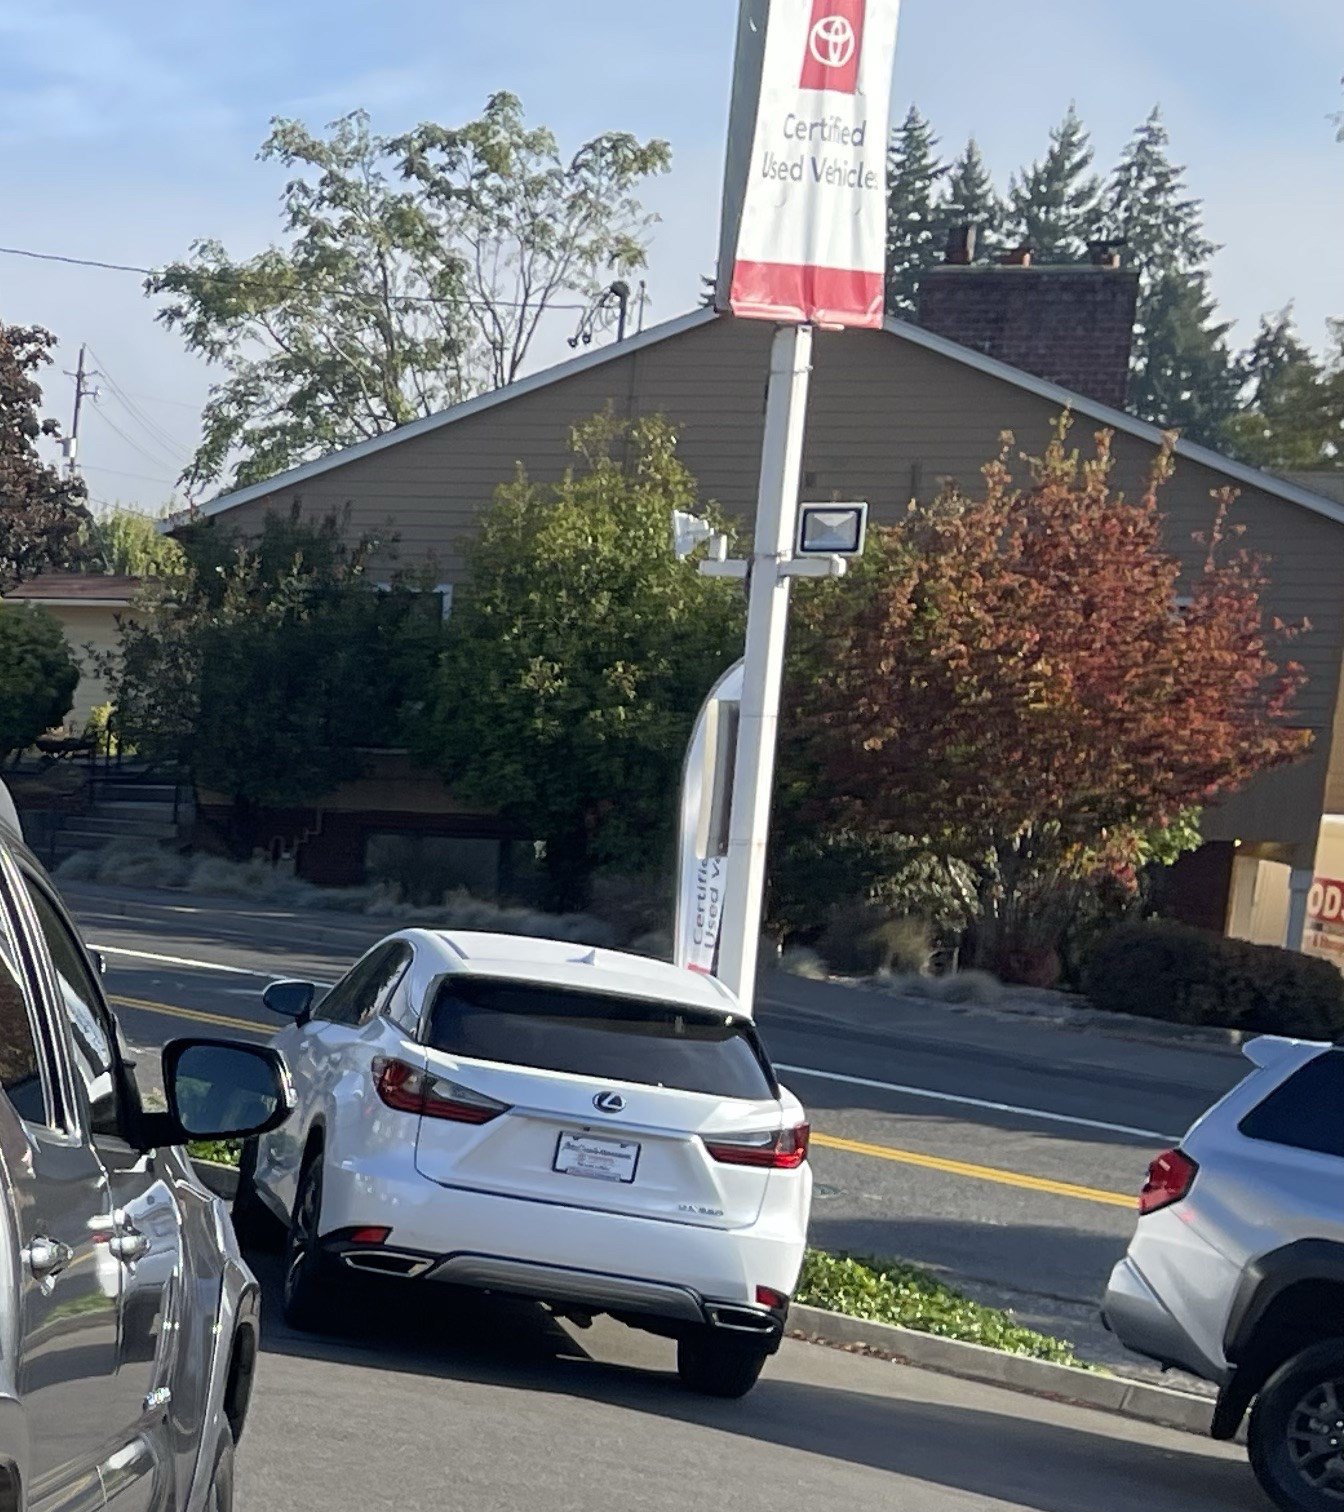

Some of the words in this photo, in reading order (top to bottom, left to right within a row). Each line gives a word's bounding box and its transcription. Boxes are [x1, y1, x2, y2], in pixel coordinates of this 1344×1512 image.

[783, 113, 867, 148] Certified
[762, 151, 804, 183] Used
[704, 886, 719, 949] Used
